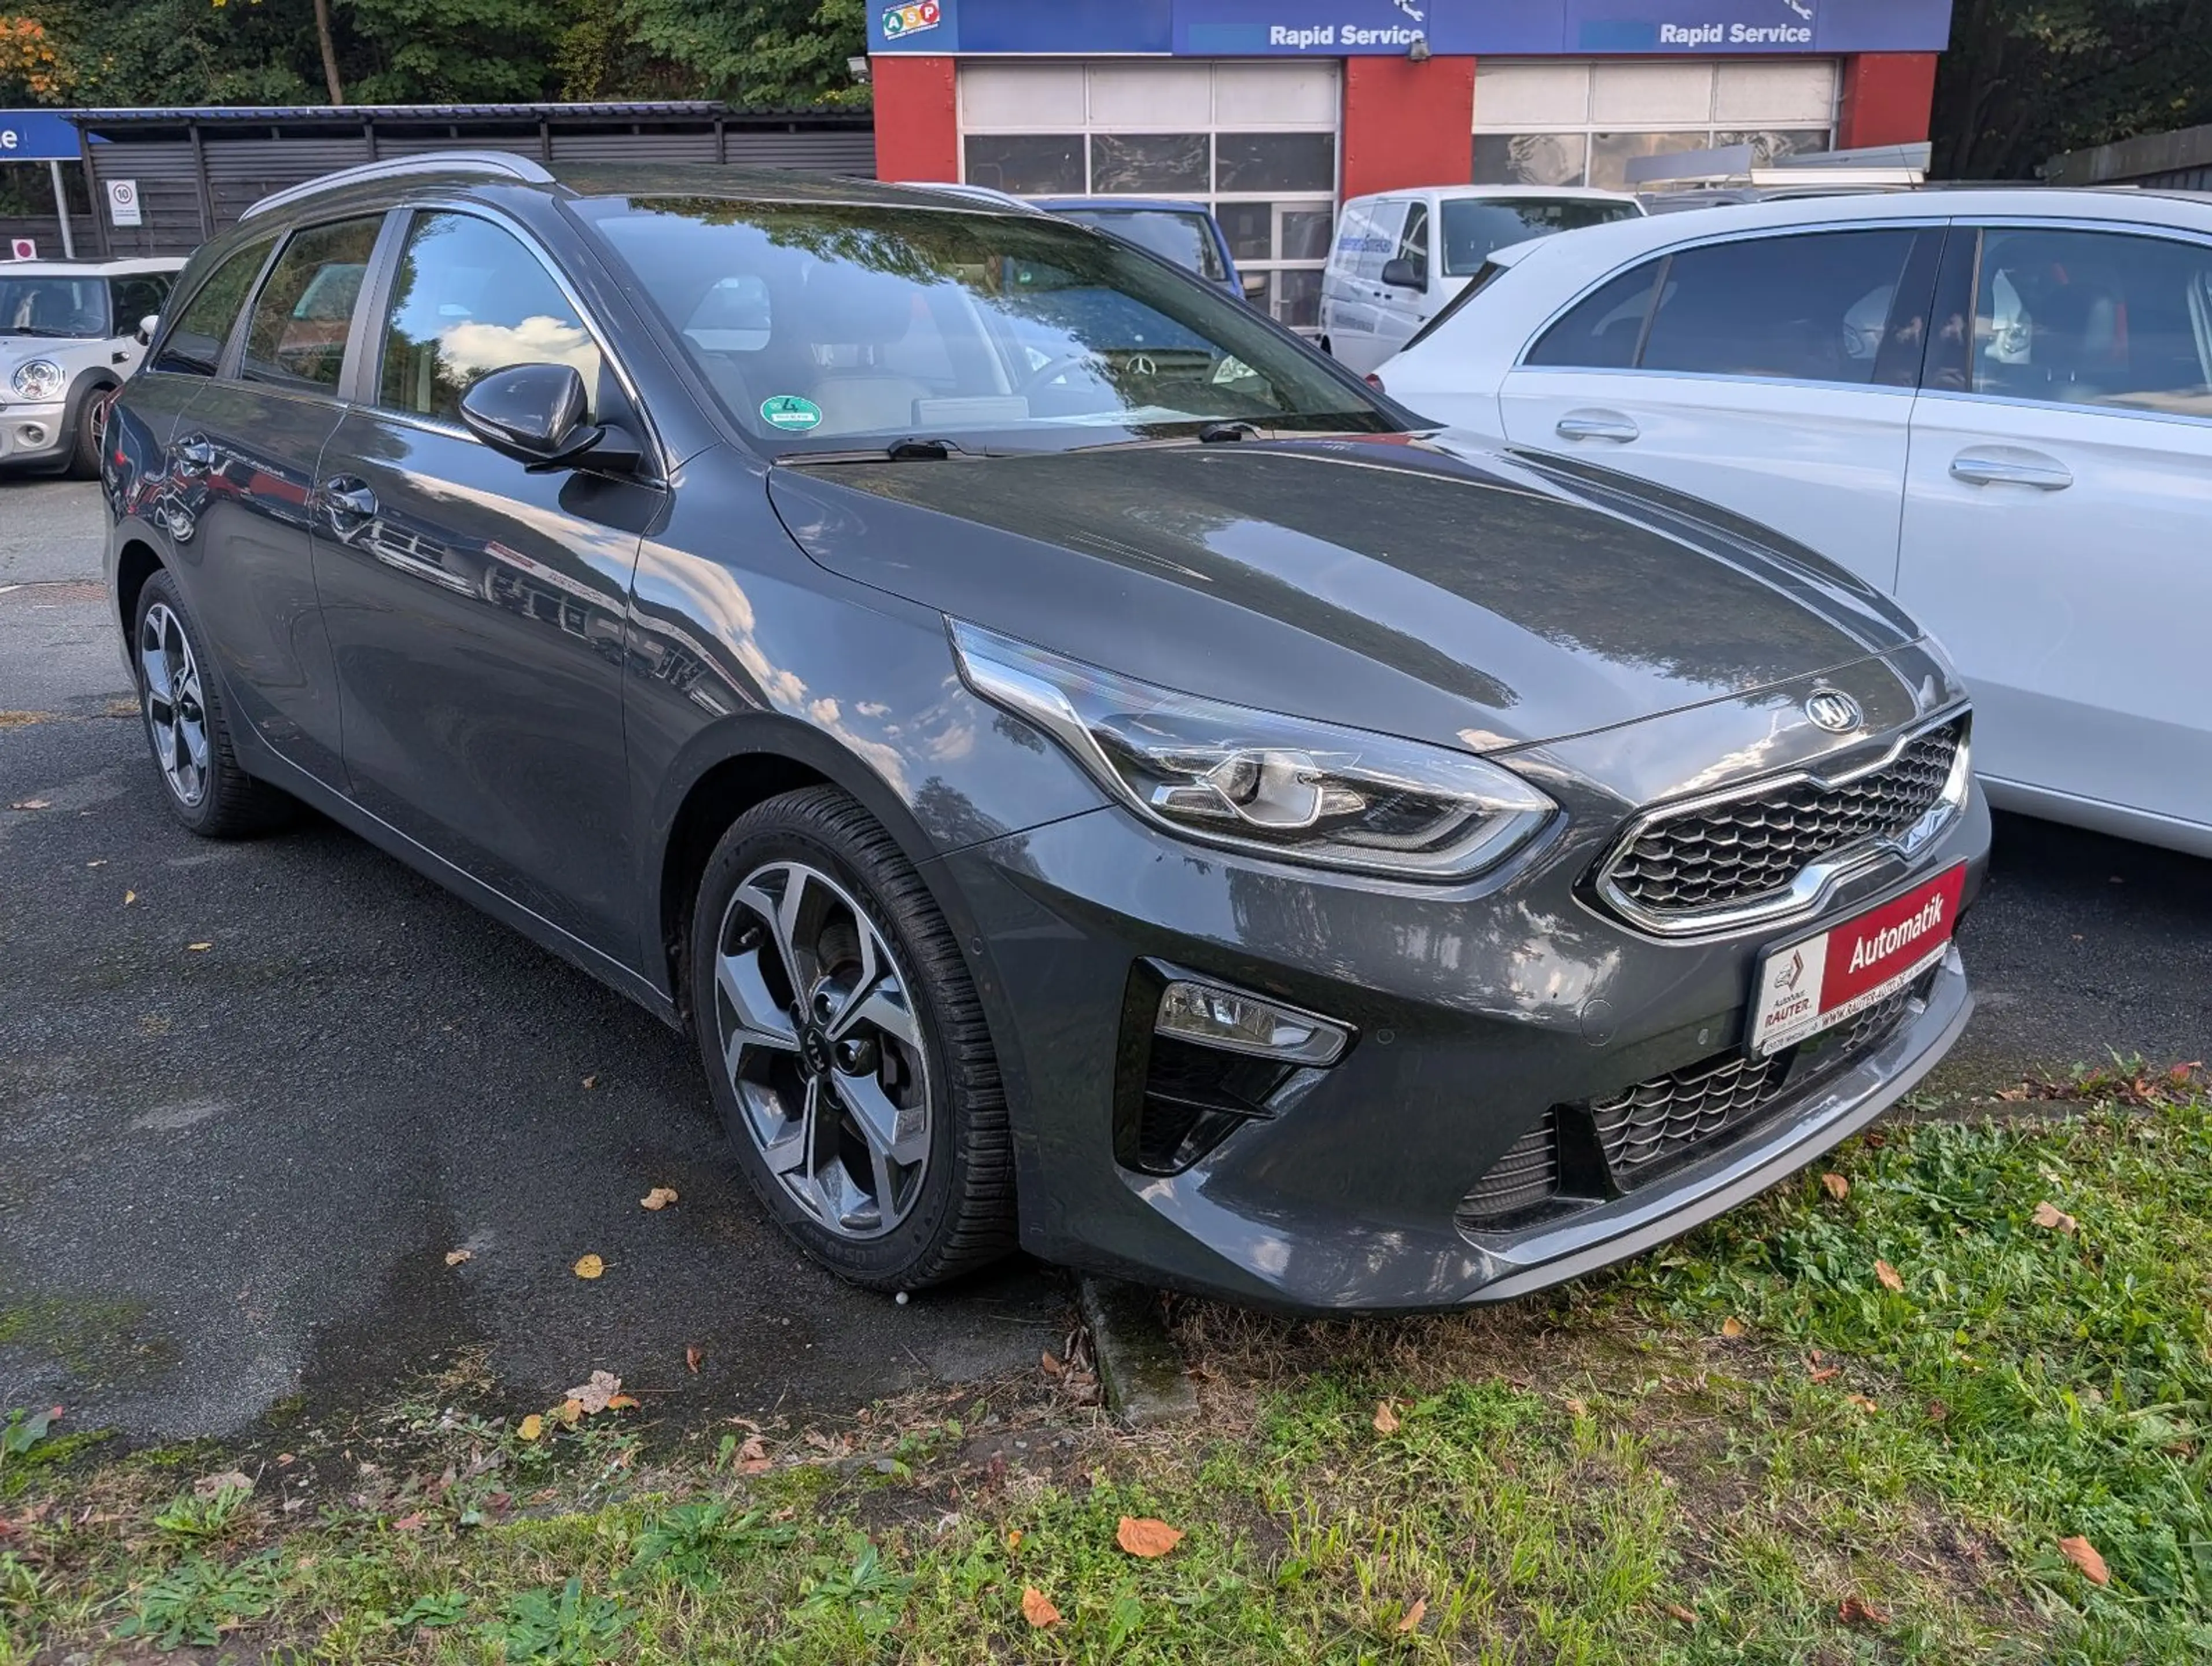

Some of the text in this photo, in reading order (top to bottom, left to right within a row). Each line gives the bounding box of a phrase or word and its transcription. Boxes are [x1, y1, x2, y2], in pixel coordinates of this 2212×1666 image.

[1270, 24, 1425, 49] Rapid Service
[1660, 23, 1812, 47] Rapid Service
[117, 187, 130, 201] 10
[782, 398, 799, 413] 4
[1848, 892, 1944, 974] Automatik
